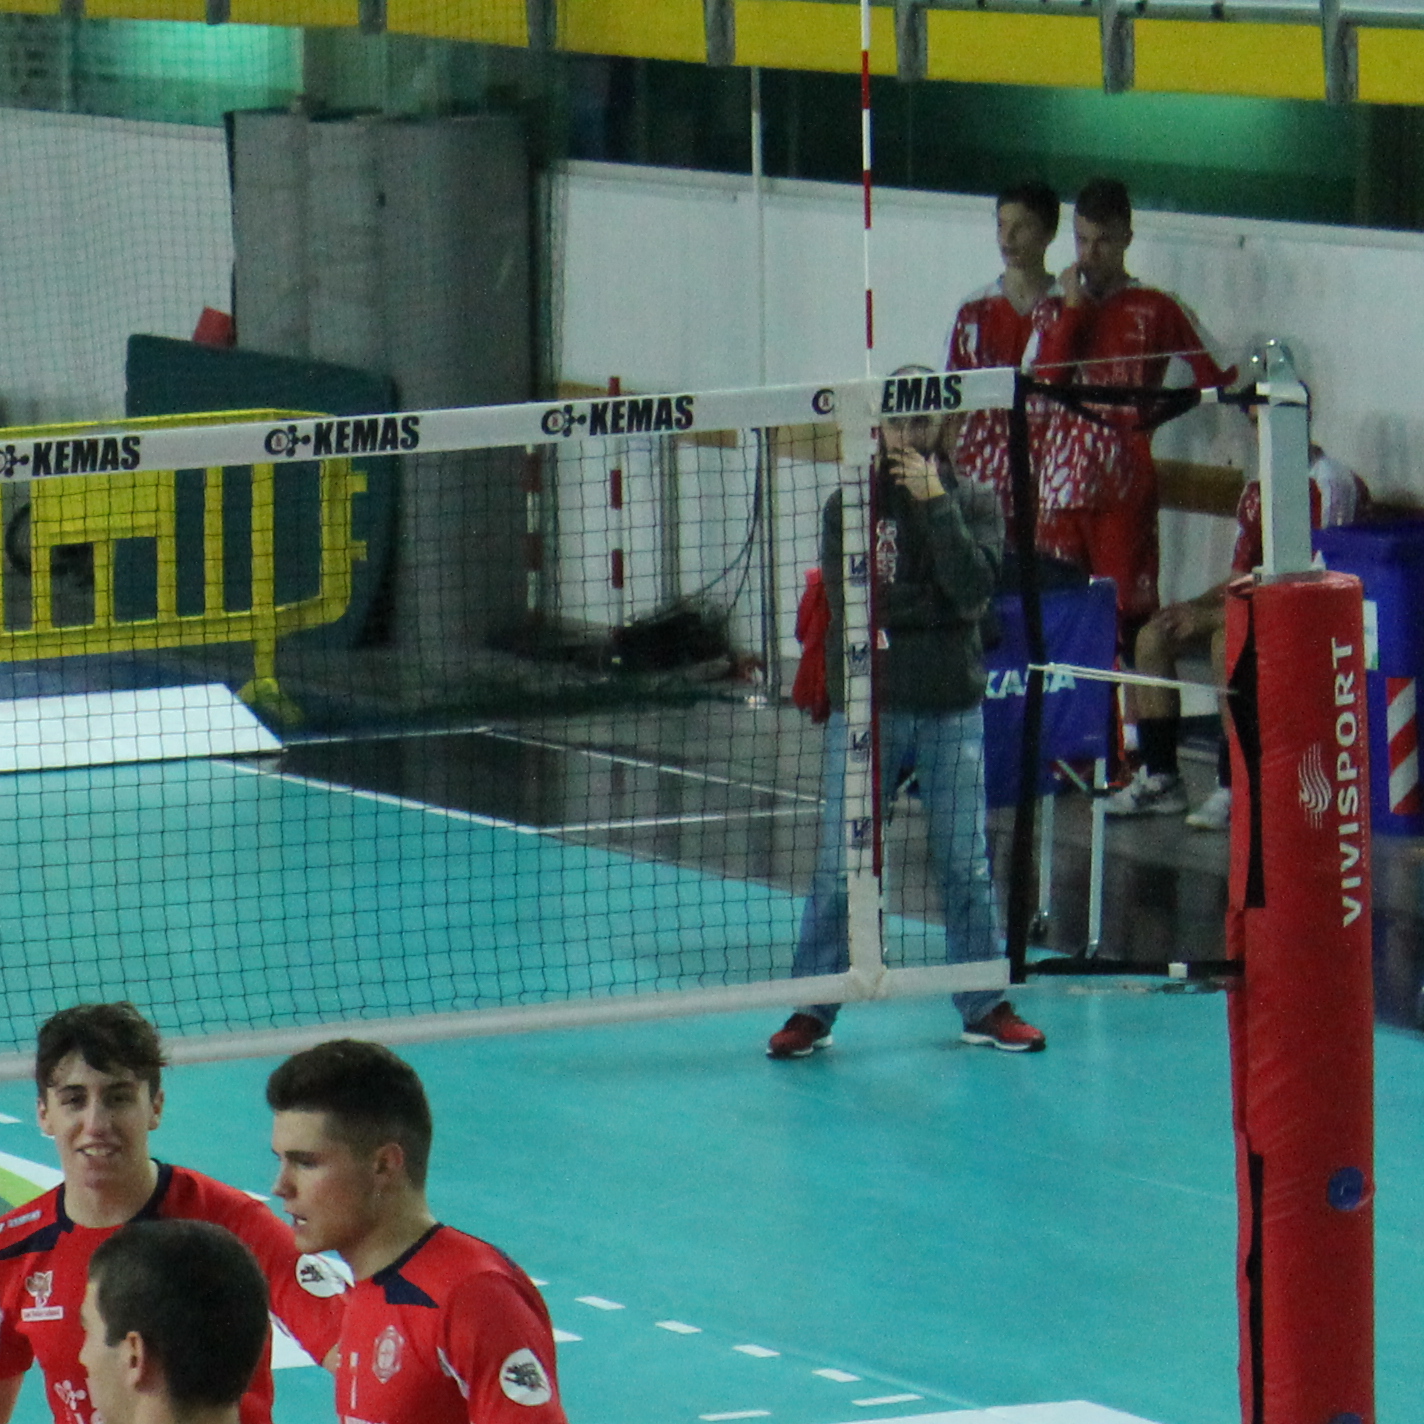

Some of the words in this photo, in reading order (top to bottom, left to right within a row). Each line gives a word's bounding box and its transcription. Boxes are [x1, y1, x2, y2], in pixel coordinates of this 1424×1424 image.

[882, 375, 962, 413] EMAS
[589, 394, 694, 435] KEMAS
[32, 436, 140, 475] KEMAS
[313, 416, 419, 456] KEMAS
[1330, 637, 1362, 928] VIVISPORT
